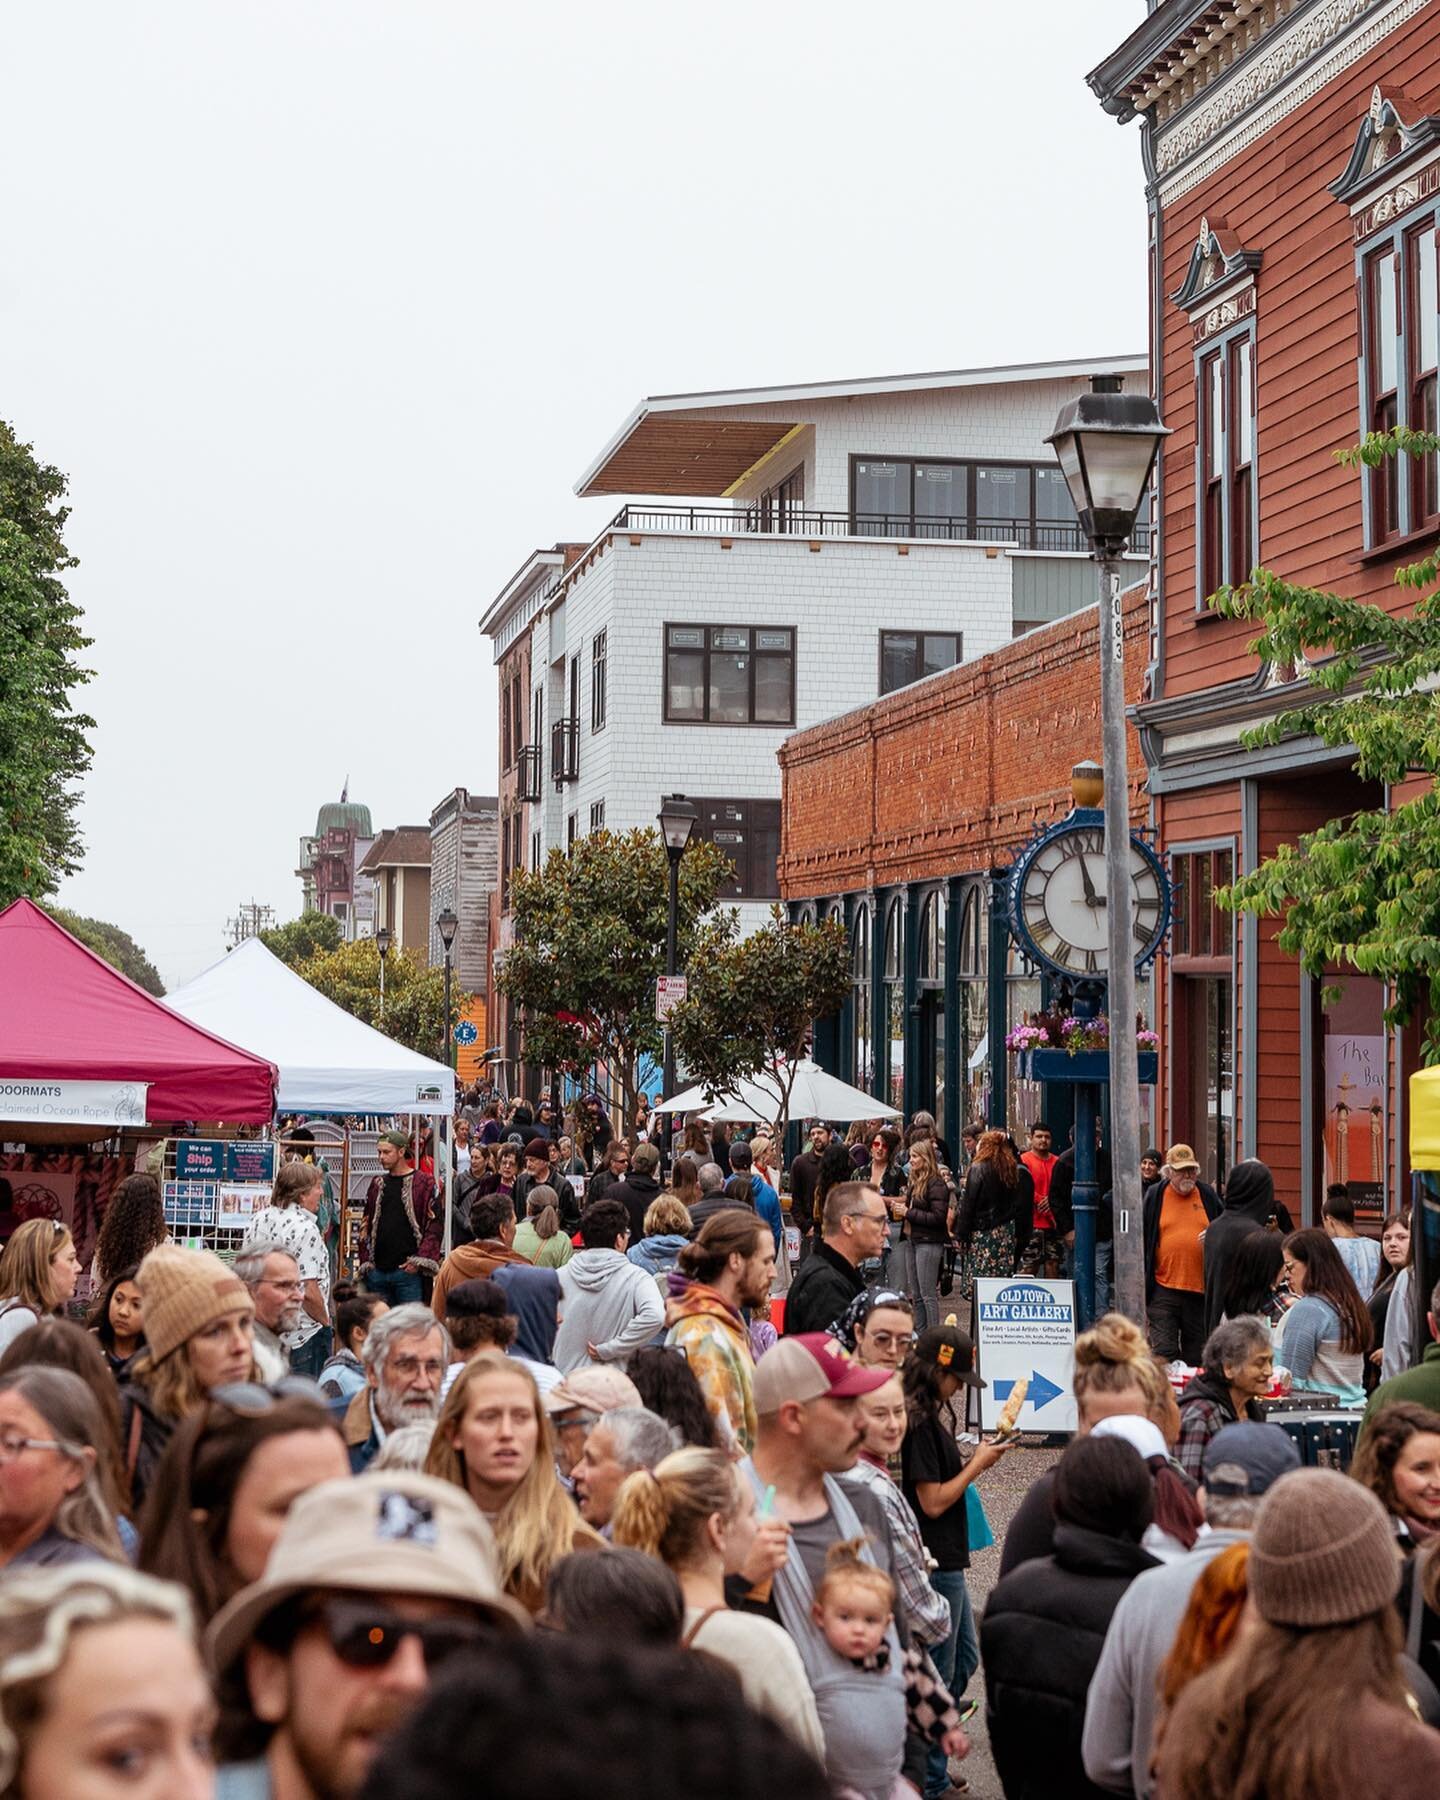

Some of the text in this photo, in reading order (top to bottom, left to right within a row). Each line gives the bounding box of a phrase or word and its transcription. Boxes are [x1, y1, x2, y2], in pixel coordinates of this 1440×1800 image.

[1114, 577, 1122, 660] 7083
[1337, 1040, 1370, 1062] The
[42, 1103, 80, 1116] Ocean
[83, 1105, 110, 1119] Rope
[187, 1153, 213, 1166] Ship
[1001, 1290, 1051, 1302] OLD TOWN
[983, 1305, 1070, 1320] ART GALLERY
